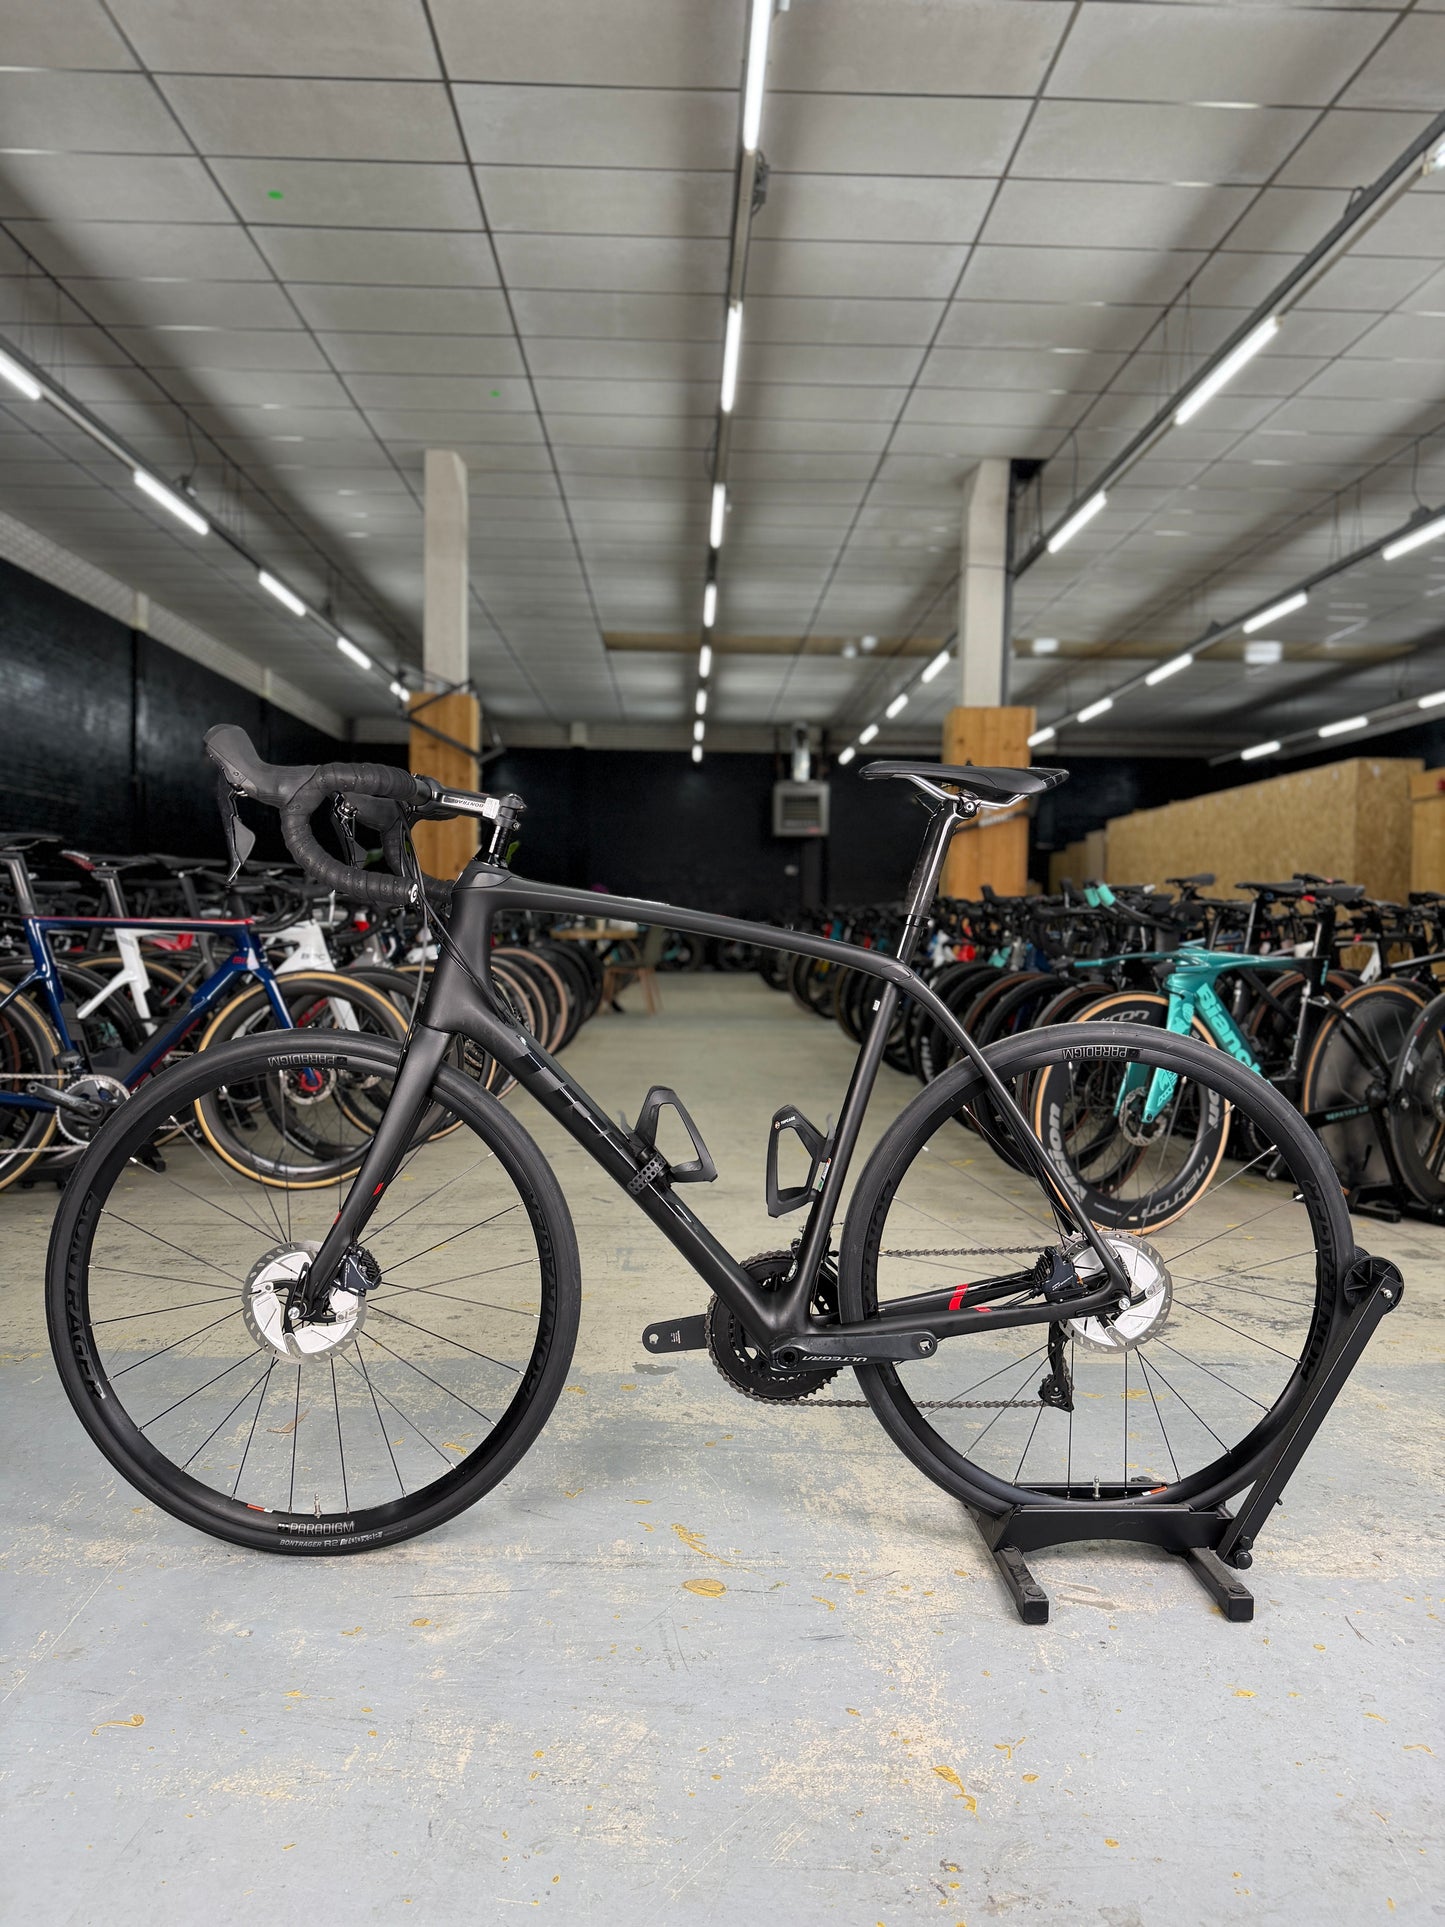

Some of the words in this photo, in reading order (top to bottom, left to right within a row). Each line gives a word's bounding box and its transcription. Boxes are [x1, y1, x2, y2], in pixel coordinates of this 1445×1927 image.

[1062, 1047, 1127, 1060] PARADIGM
[267, 1055, 335, 1067] PARADIGM
[290, 1520, 355, 1534] PARADIGM
[280, 1539, 321, 1548] BONTRAGER
